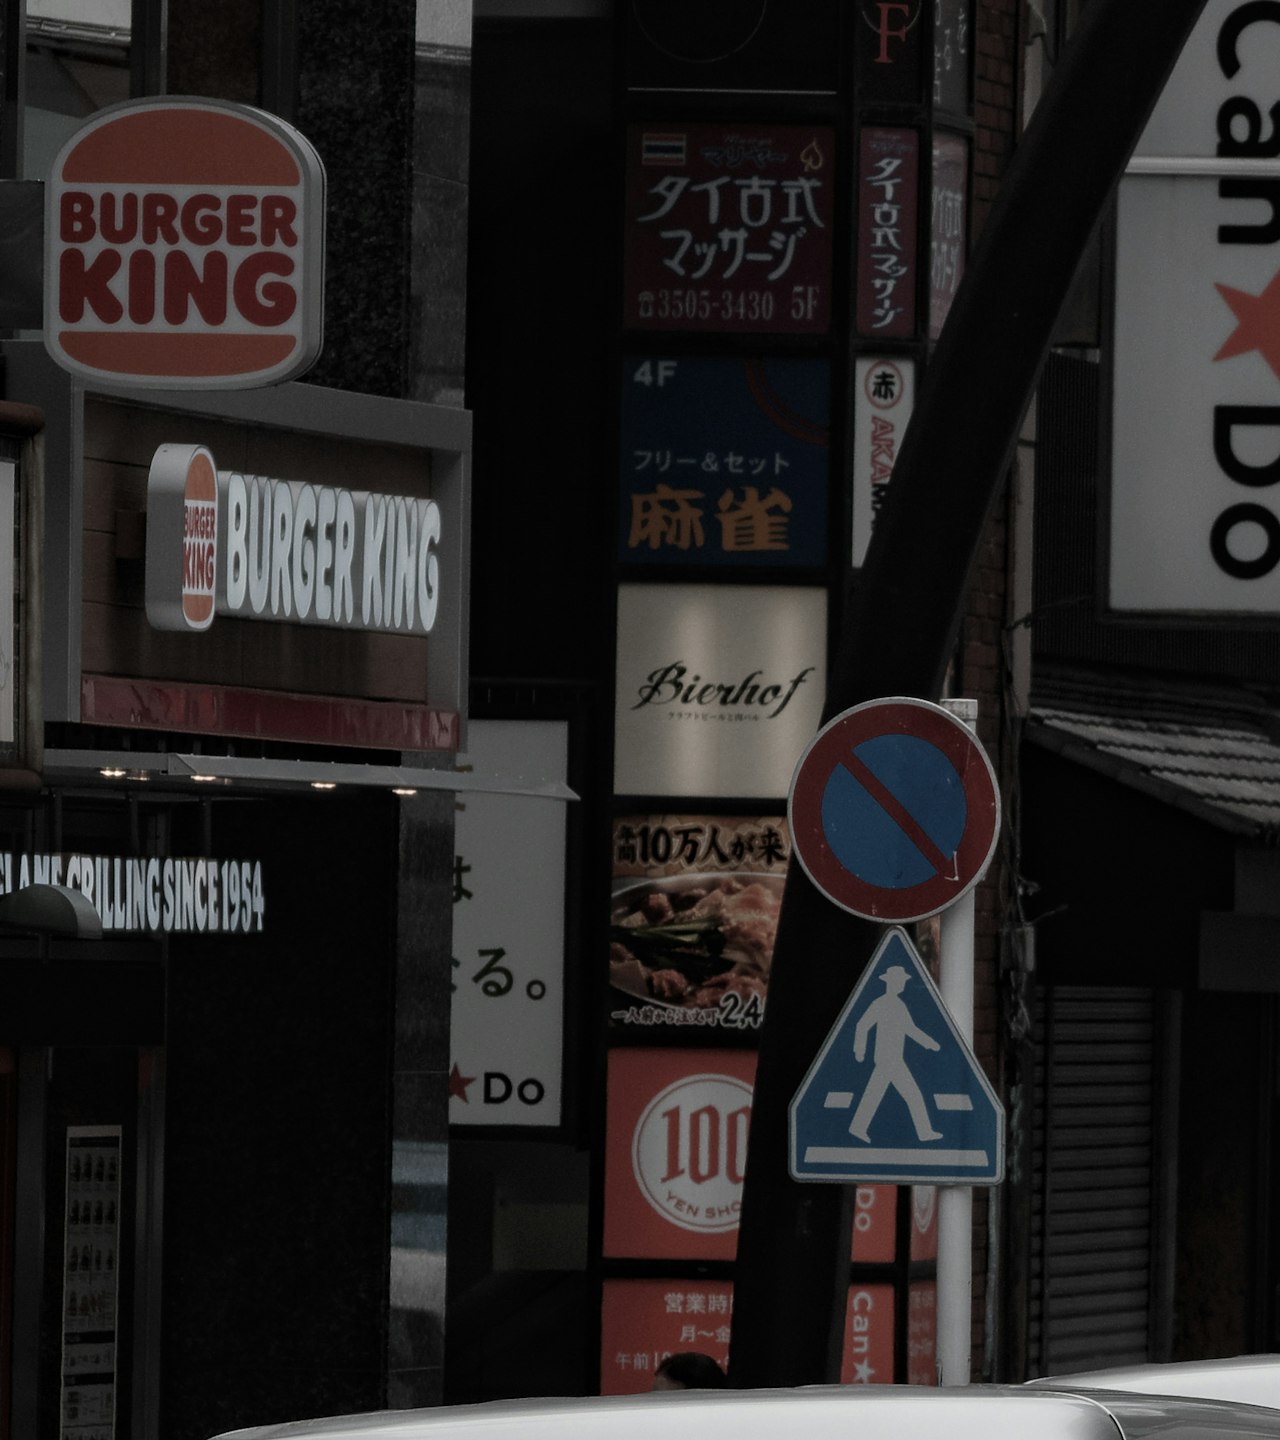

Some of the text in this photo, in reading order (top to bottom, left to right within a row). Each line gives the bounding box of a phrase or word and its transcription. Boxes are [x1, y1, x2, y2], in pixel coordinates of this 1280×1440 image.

[60, 191, 298, 247] BURGER
[636, 175, 824, 228] タイ古式
[660, 227, 807, 281] マッサージ
[866, 157, 908, 328] タイ古式マッサージ
[59, 249, 296, 327] KING
[658, 286, 820, 320] 3505-3430 5F
[633, 360, 677, 387] 4F
[872, 371, 896, 400] 赤
[183, 505, 215, 541] BURGER
[628, 484, 793, 553] 麻雀
[183, 542, 215, 592] KING
[226, 472, 441, 632] BURGER KING
[630, 660, 816, 719] Bierhof
[162, 857, 219, 932] SINCE
[221, 859, 266, 932] 1954
[483, 1071, 545, 1105] Do
[661, 1104, 753, 1185] 100
[667, 1190, 699, 1220] YEN
[855, 1187, 876, 1232] Do
[664, 1292, 733, 1315] 営業時
[853, 1291, 874, 1353] Can
